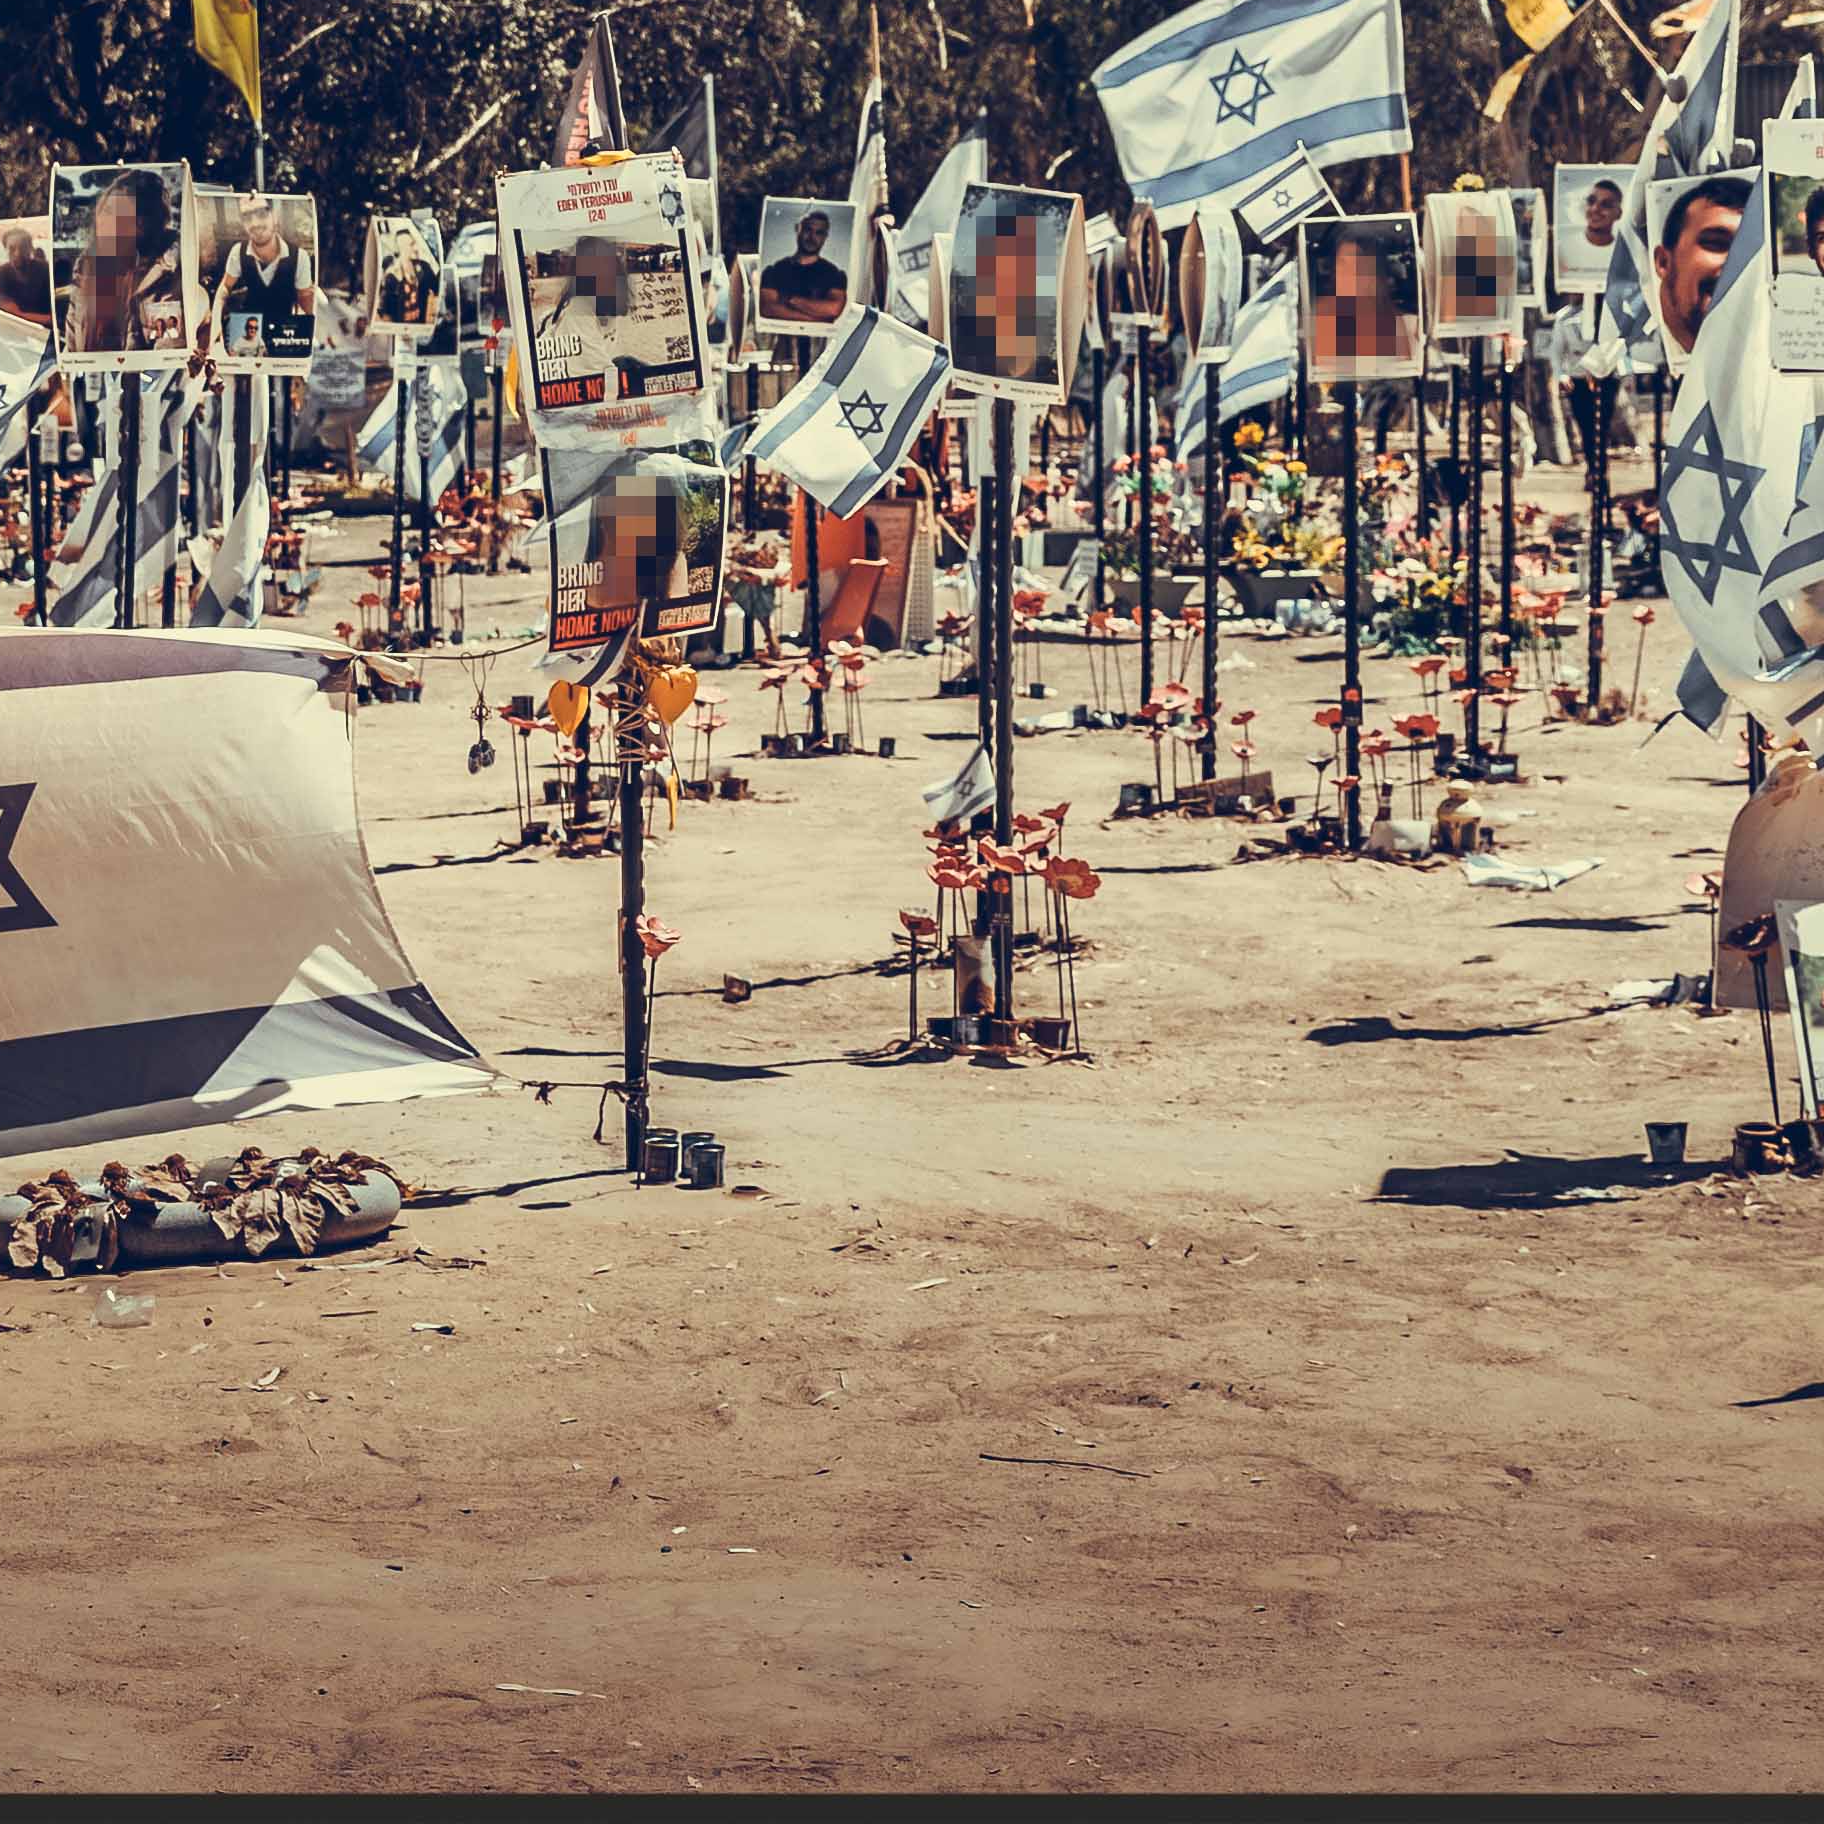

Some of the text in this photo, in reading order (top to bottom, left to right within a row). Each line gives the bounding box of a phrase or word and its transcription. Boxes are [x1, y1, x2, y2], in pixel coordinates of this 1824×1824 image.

[557, 191, 633, 212] EDEN YERUSHALMI
[588, 208, 607, 223] (24)
[536, 335, 582, 360] BRING
[539, 360, 568, 382] HER
[541, 380, 585, 406] HOME
[559, 561, 604, 589] BRING
[557, 588, 587, 614] HER
[556, 613, 597, 640] HOME
